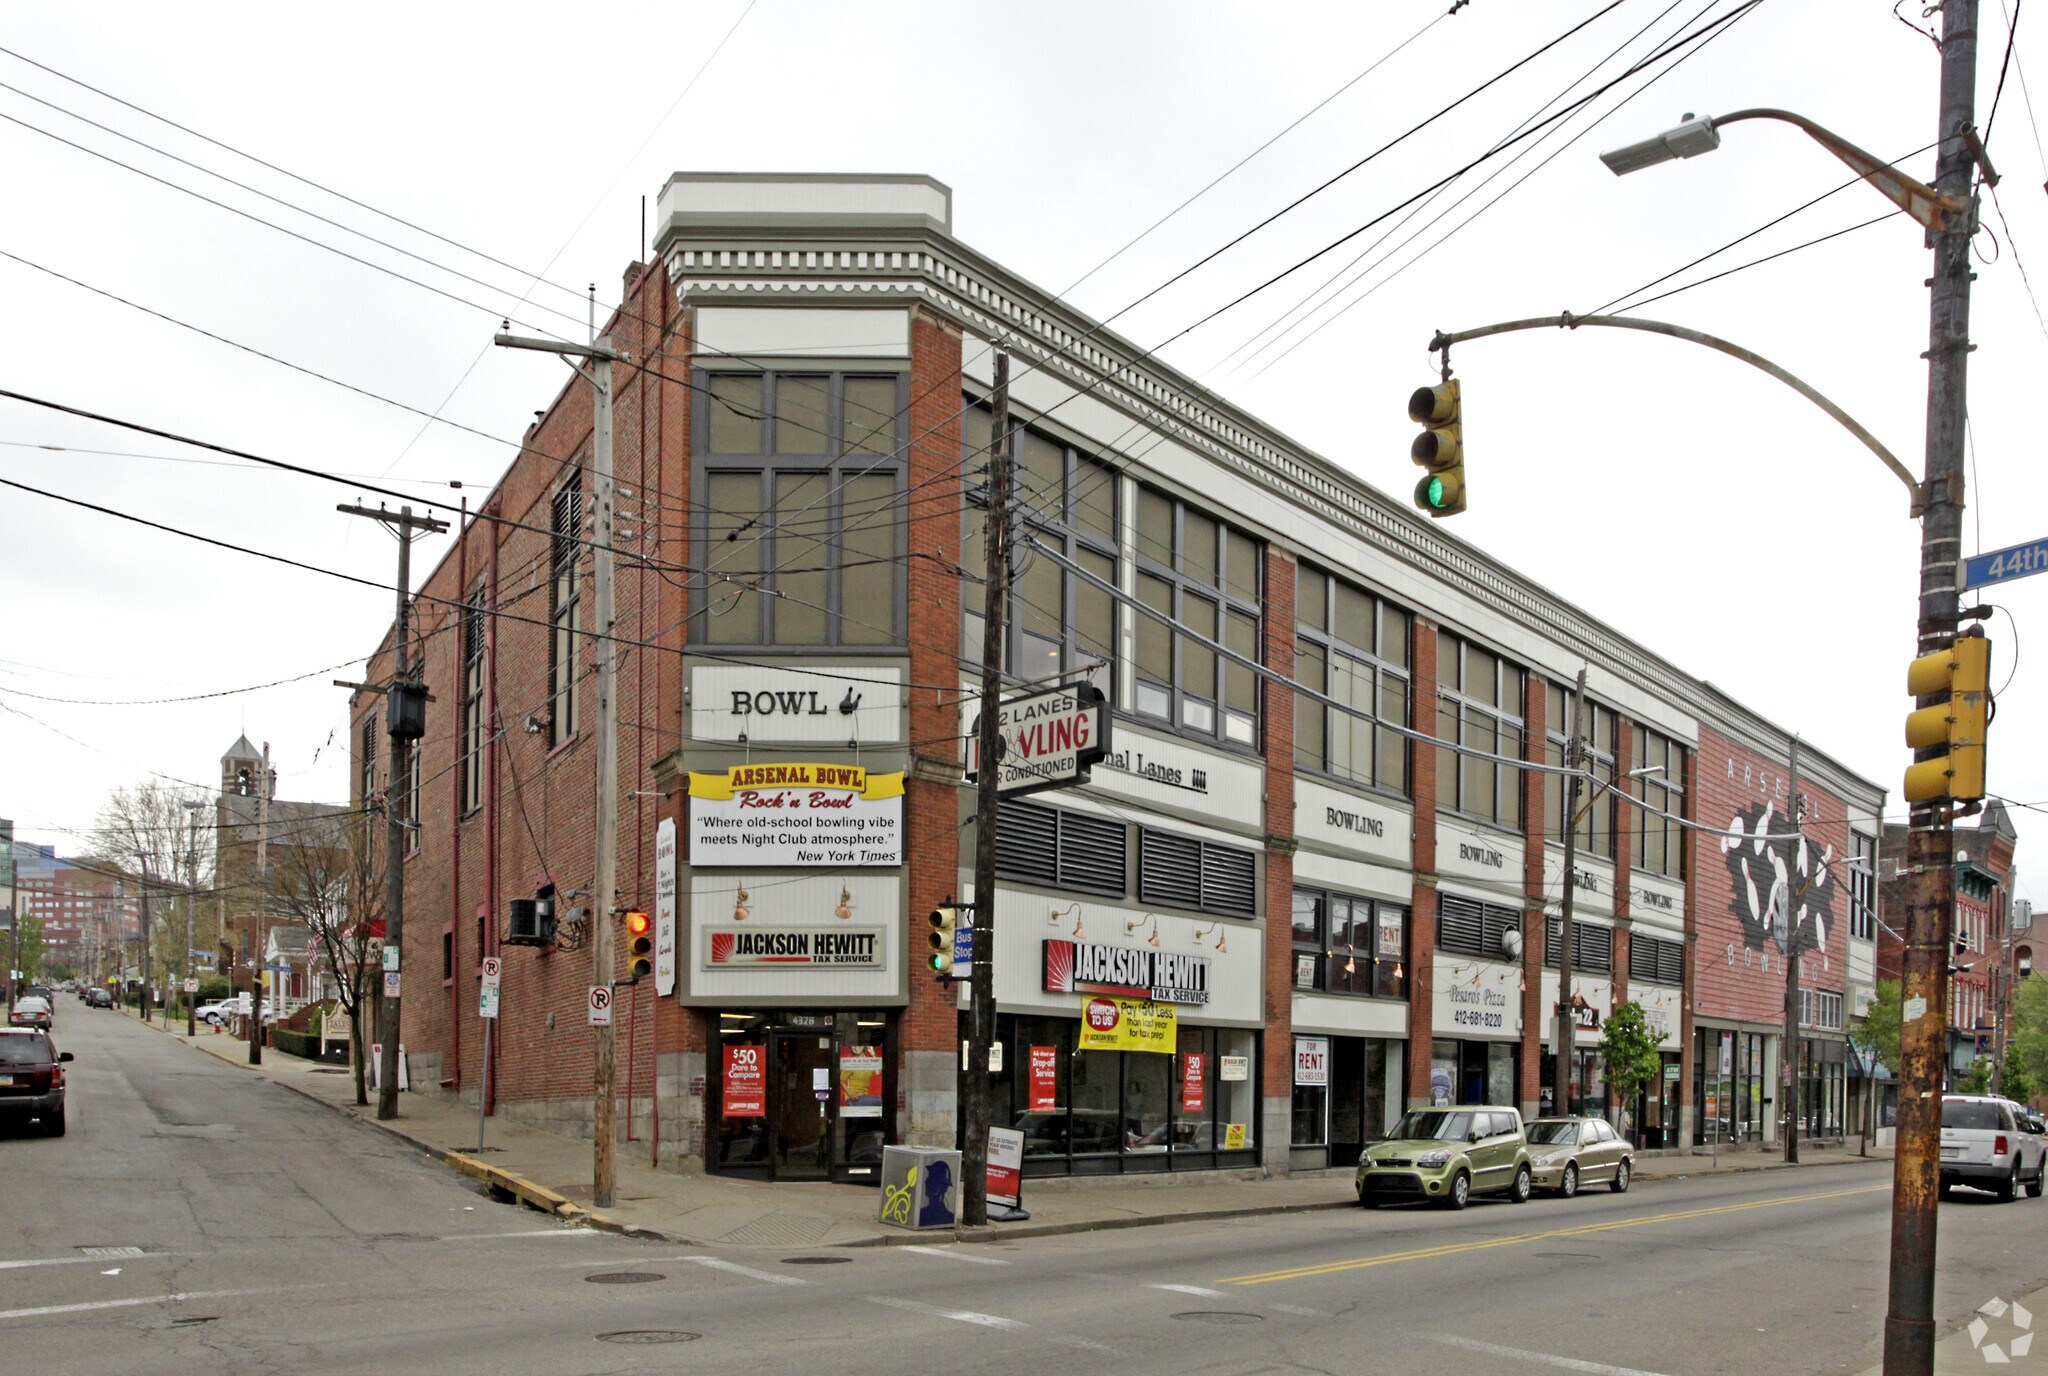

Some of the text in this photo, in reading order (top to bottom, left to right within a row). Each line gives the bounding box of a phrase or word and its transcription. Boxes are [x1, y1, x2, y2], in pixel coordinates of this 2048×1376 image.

[1988, 545, 2048, 578] 44th
[731, 691, 827, 715] BOWL
[1014, 697, 1073, 723] LANES
[732, 766, 862, 787] ARSENAL BOWL
[1005, 757, 1075, 782] CONDITIONED
[1137, 753, 1182, 784] Lanes
[1727, 758, 1819, 818] ARSEAL
[808, 792, 853, 808] Bowl
[747, 816, 812, 828] old-school
[816, 816, 864, 830] bowling
[868, 816, 894, 828] vibe
[1326, 807, 1384, 838] BOWLING
[700, 834, 738, 844] meets
[742, 834, 775, 847] Night
[778, 834, 807, 844] Club
[796, 850, 896, 862] New York Times
[1460, 844, 1502, 868] BOWLING
[1644, 890, 1672, 910] BOWLING
[956, 931, 972, 944] Bus
[1379, 926, 1400, 944] RENT
[736, 934, 876, 954] JACKSON HEWITT
[954, 946, 972, 959] Stop
[1074, 943, 1211, 991] JACKSON HEWITT
[1727, 944, 1818, 982] BOWLNG
[1300, 967, 1313, 978] RENT
[1152, 987, 1209, 1003] TAX SERVICE
[1450, 984, 1506, 1006] Pesaro's Pizza
[1090, 1004, 1116, 1016] SWITCH
[1120, 1002, 1138, 1017] Pay
[1156, 1004, 1174, 1019] Less
[792, 1016, 814, 1026] 4328
[1092, 1016, 1114, 1026] TO US!
[1127, 1017, 1142, 1026] than
[1155, 1020, 1168, 1030] year
[1454, 1010, 1502, 1028] 412-681-8220
[1130, 1028, 1138, 1038] for
[1139, 1029, 1150, 1038] tax
[1306, 1042, 1316, 1051] FOR
[733, 1048, 756, 1064] $50
[1032, 1058, 1054, 1069] Drop-off
[1188, 1056, 1200, 1068] $50
[1298, 1053, 1324, 1070] RENT
[728, 1070, 760, 1080] Compare
[1036, 1068, 1054, 1078] Service
